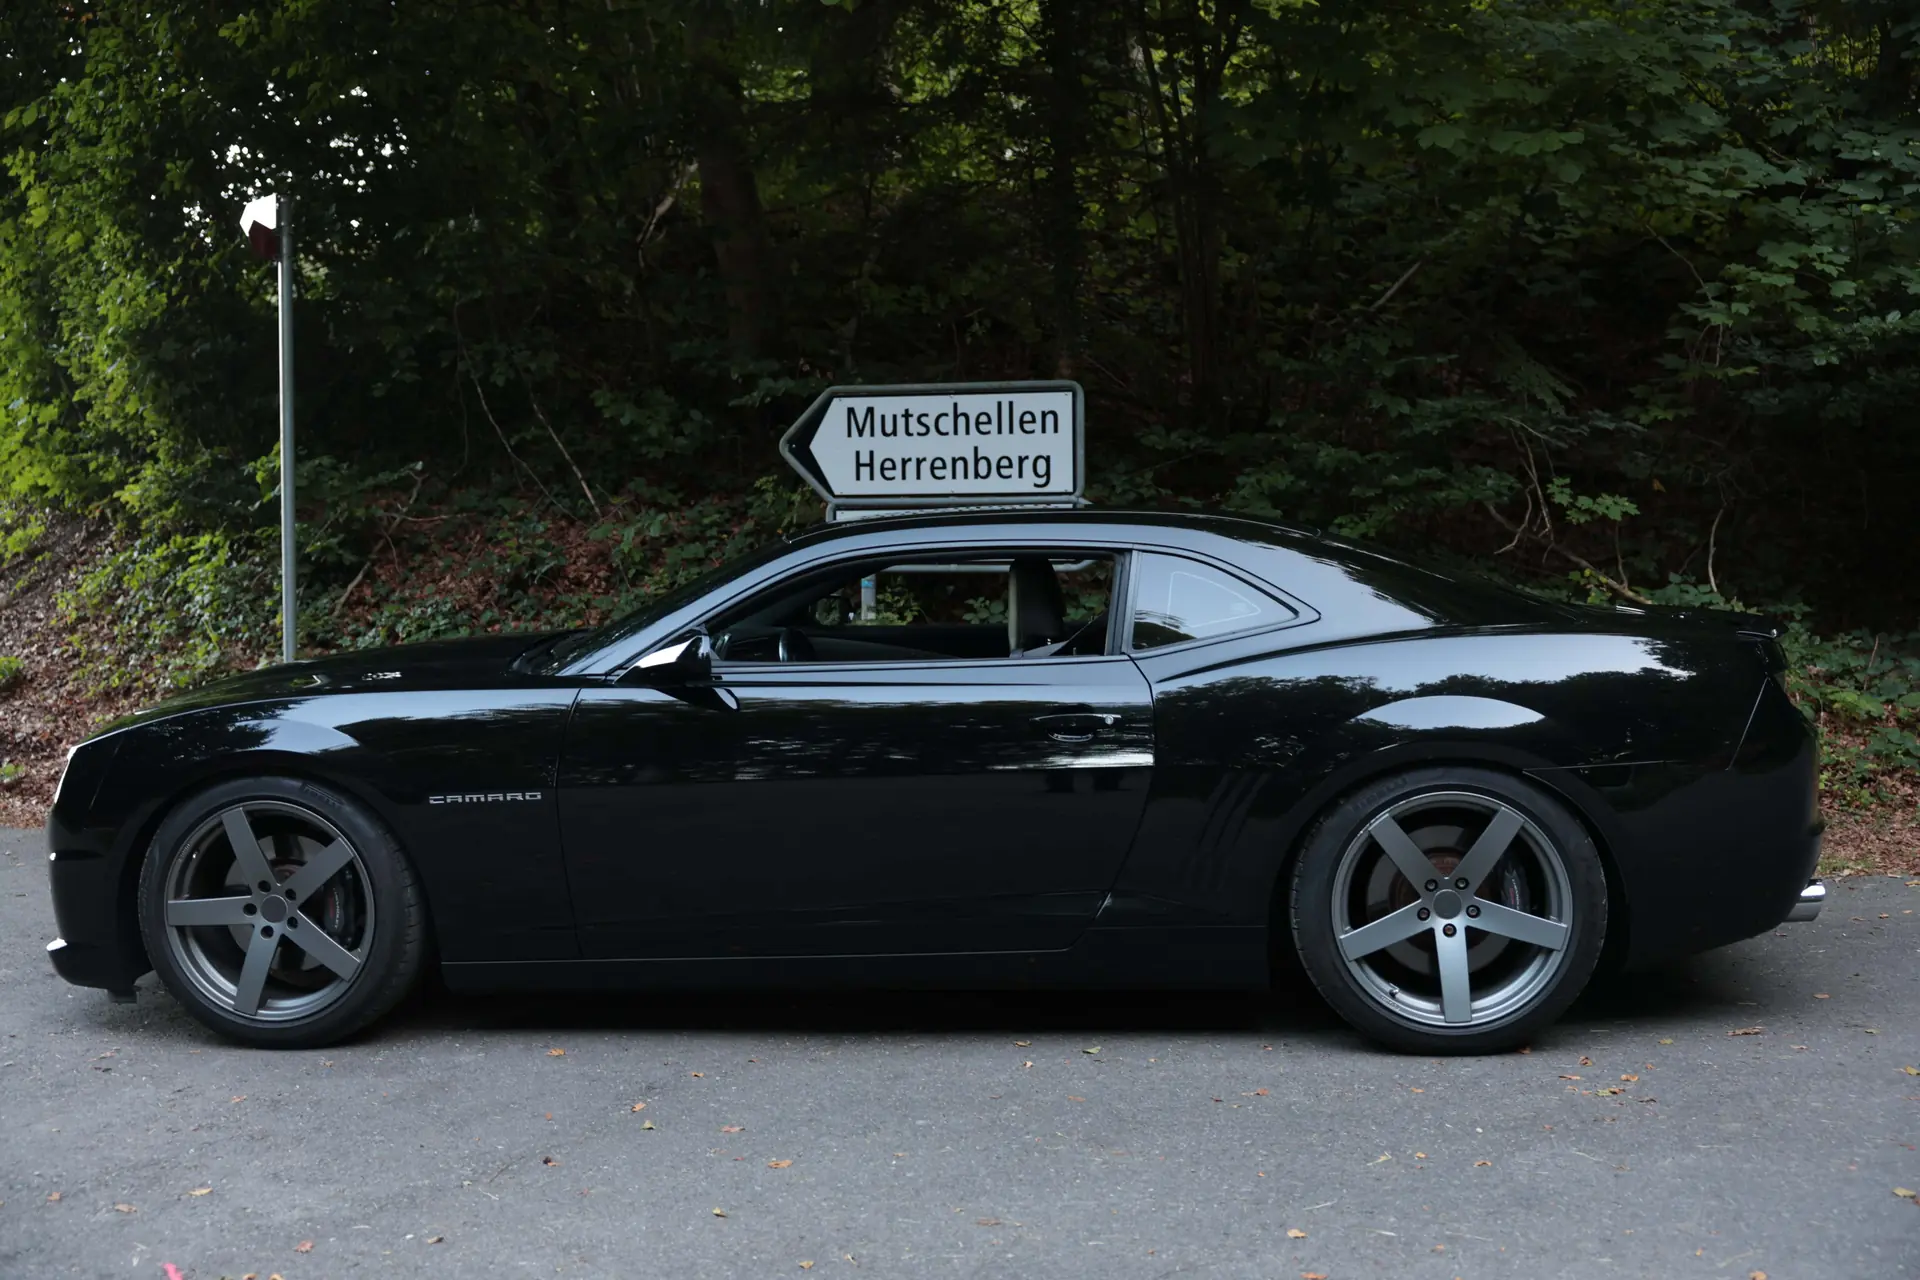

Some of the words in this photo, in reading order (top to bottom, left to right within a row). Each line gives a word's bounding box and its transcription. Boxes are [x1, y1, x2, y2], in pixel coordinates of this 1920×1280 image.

[847, 401, 1058, 437] Mutschellen
[856, 446, 1050, 488] Herrenberg
[428, 792, 541, 804] CAMARO
